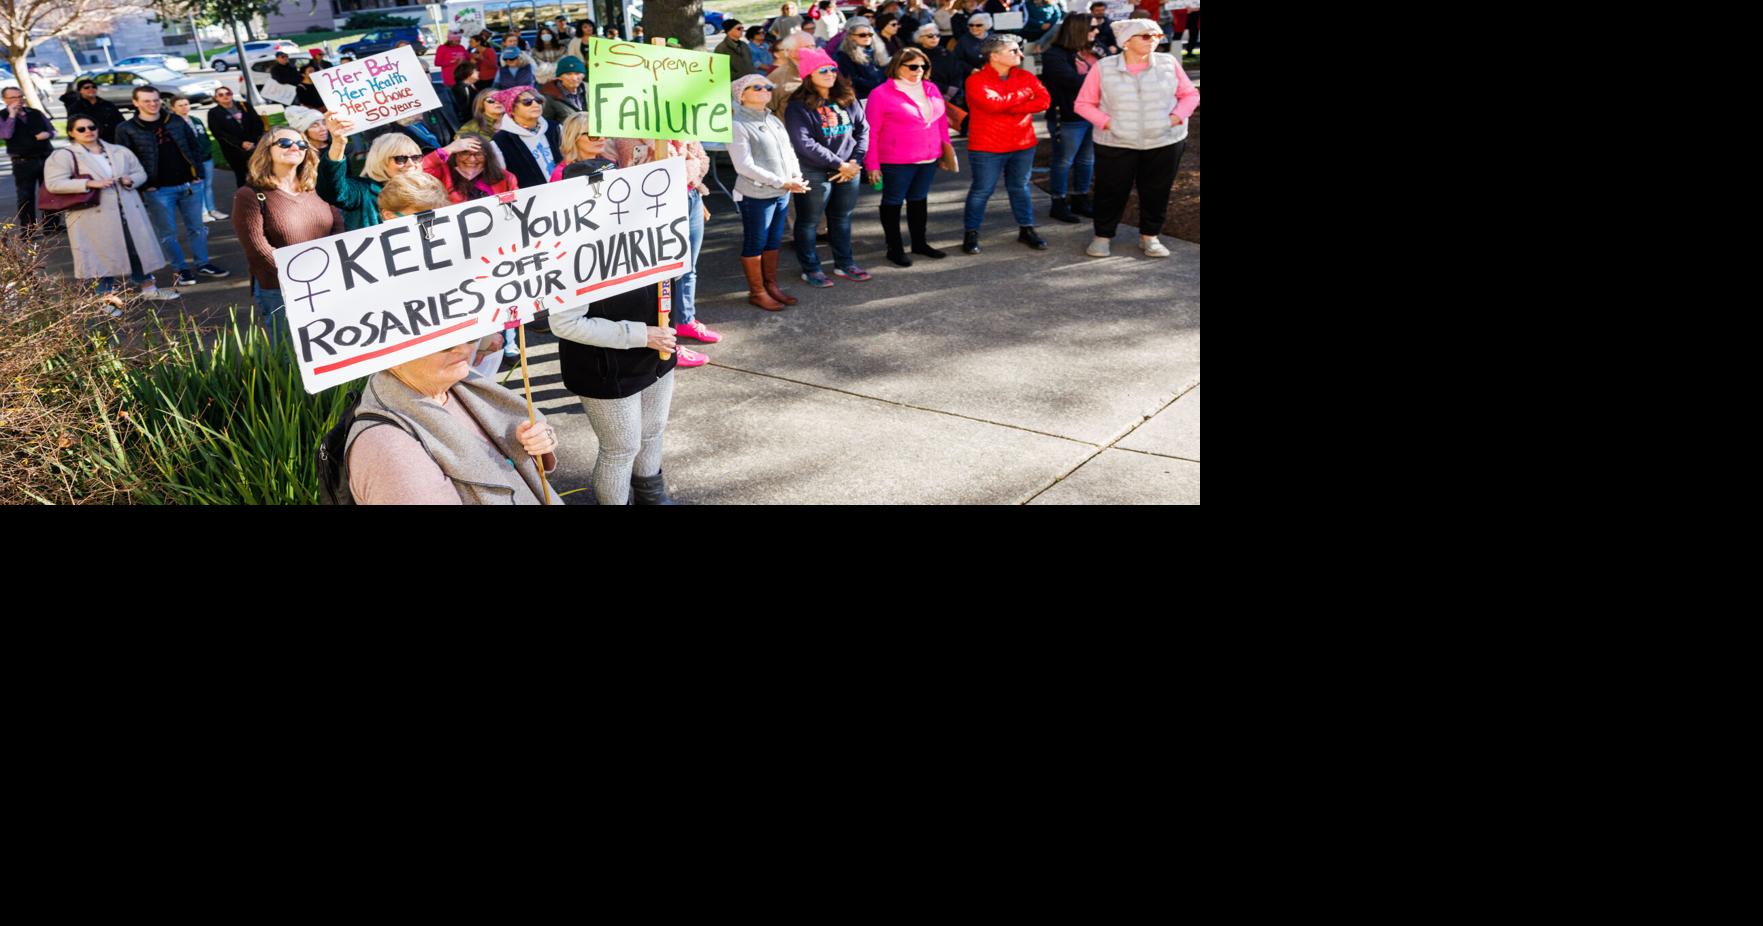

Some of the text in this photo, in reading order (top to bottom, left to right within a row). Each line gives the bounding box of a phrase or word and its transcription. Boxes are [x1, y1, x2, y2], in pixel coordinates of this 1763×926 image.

[322, 56, 400, 90] Her Body
[333, 72, 408, 103] Her Health
[340, 86, 414, 116] Her Choice
[365, 105, 391, 122] 50
[335, 205, 494, 291] KEEP
[573, 216, 688, 284] OVARIES
[492, 251, 550, 278] OFF
[495, 269, 567, 304] OUR
